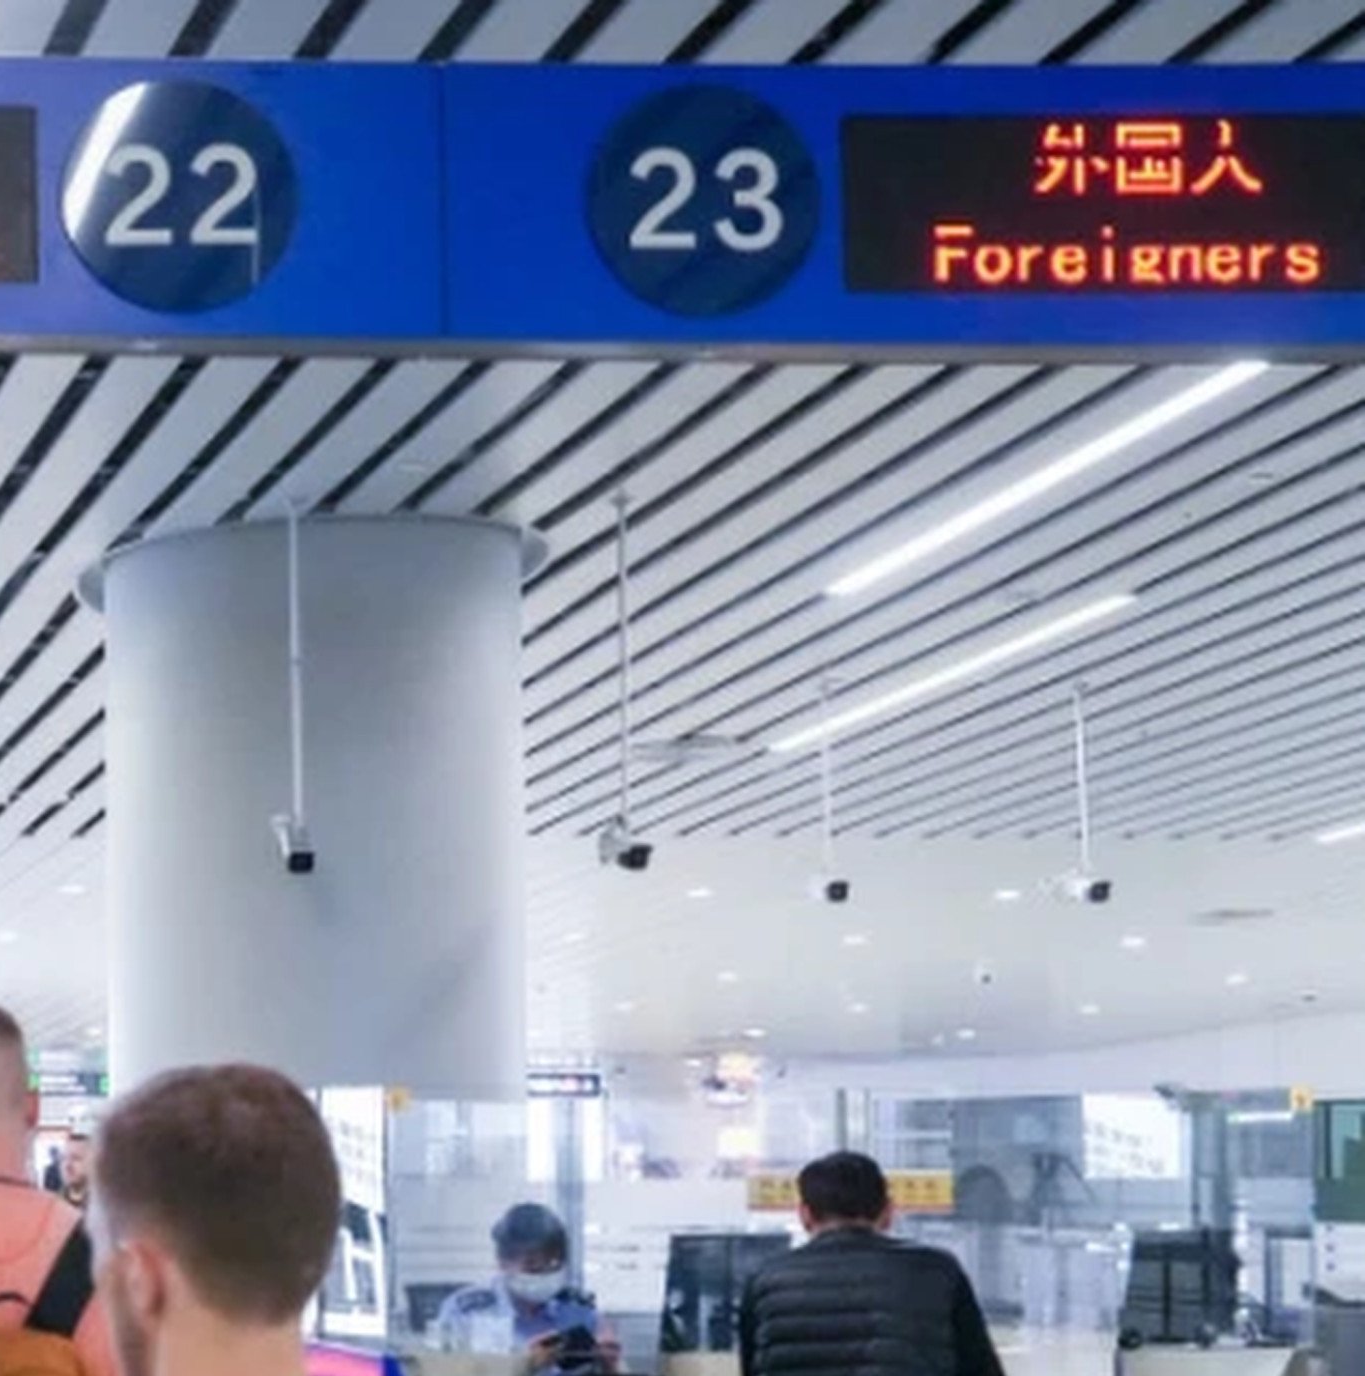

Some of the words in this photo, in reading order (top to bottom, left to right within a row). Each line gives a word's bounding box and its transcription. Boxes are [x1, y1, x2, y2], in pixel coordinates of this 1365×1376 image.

[104, 144, 257, 246] 22
[628, 147, 784, 251] 23
[1034, 120, 1264, 195] 外国人
[932, 224, 1322, 285] Foreigners
